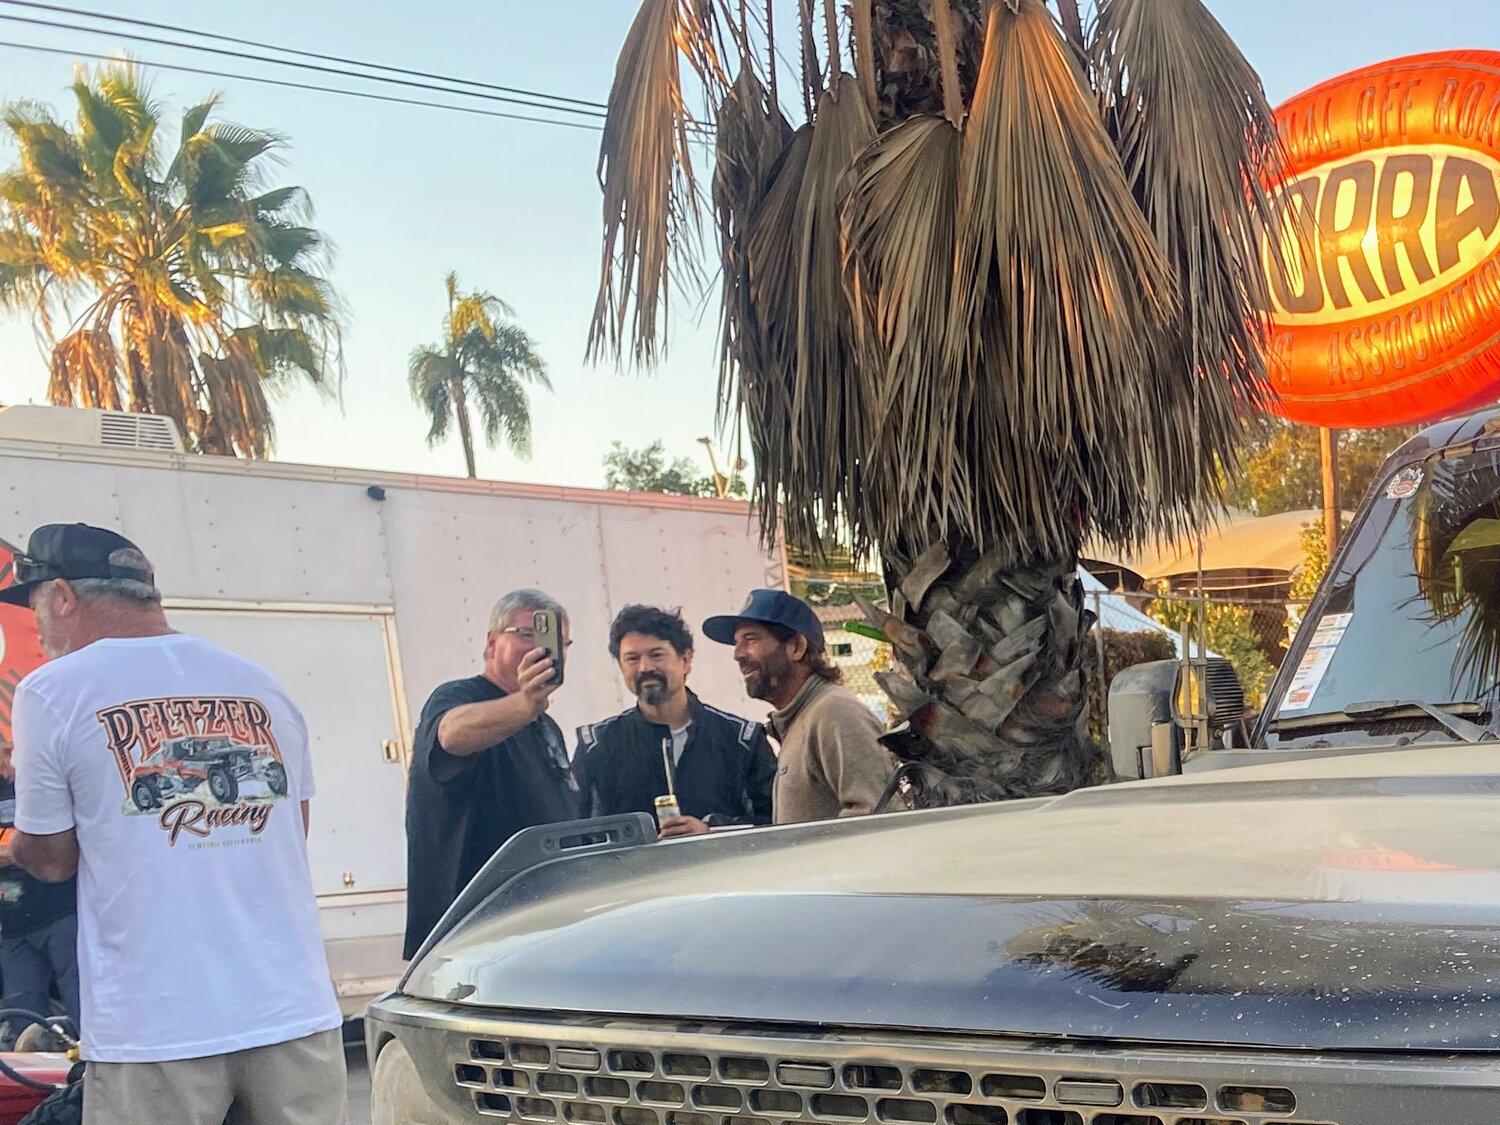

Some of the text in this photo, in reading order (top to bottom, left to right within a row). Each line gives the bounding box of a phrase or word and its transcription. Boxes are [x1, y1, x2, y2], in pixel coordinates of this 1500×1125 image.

[1356, 78, 1422, 149] OFF
[96, 697, 283, 795] PELTZER
[159, 800, 274, 846] Racing
